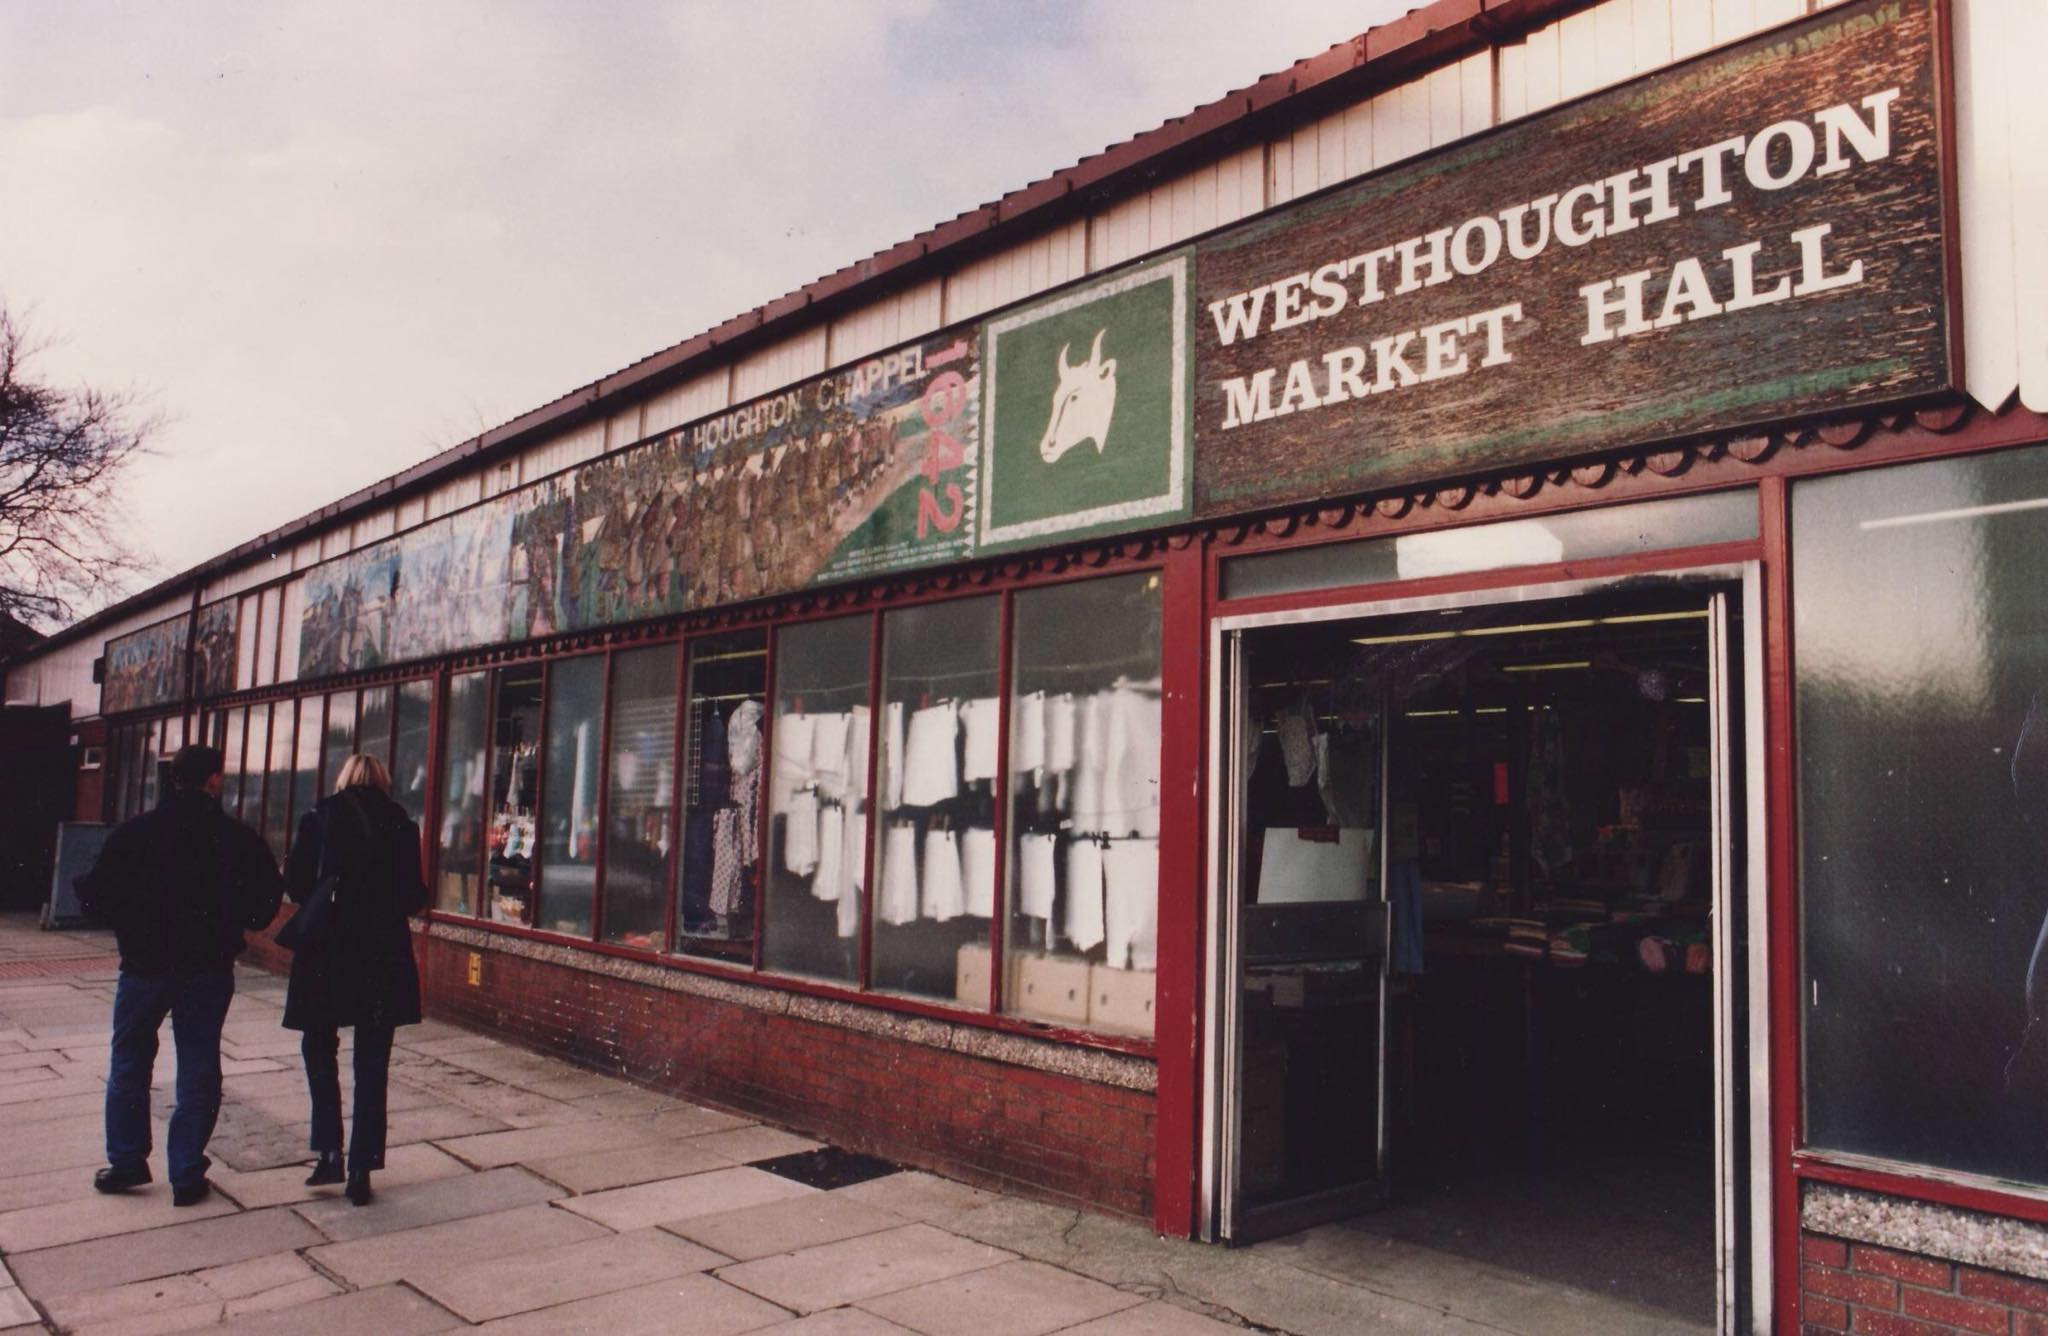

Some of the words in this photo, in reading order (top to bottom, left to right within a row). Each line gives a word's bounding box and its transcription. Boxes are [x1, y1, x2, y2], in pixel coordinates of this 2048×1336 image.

[1208, 87, 1900, 347] WESTHOUGHTON
[694, 388, 802, 453] HOUGHTON
[818, 345, 927, 412] CHAPPEL
[1222, 302, 1523, 430] MARKET
[1579, 222, 1864, 346] HALL
[917, 340, 968, 539] 1642
